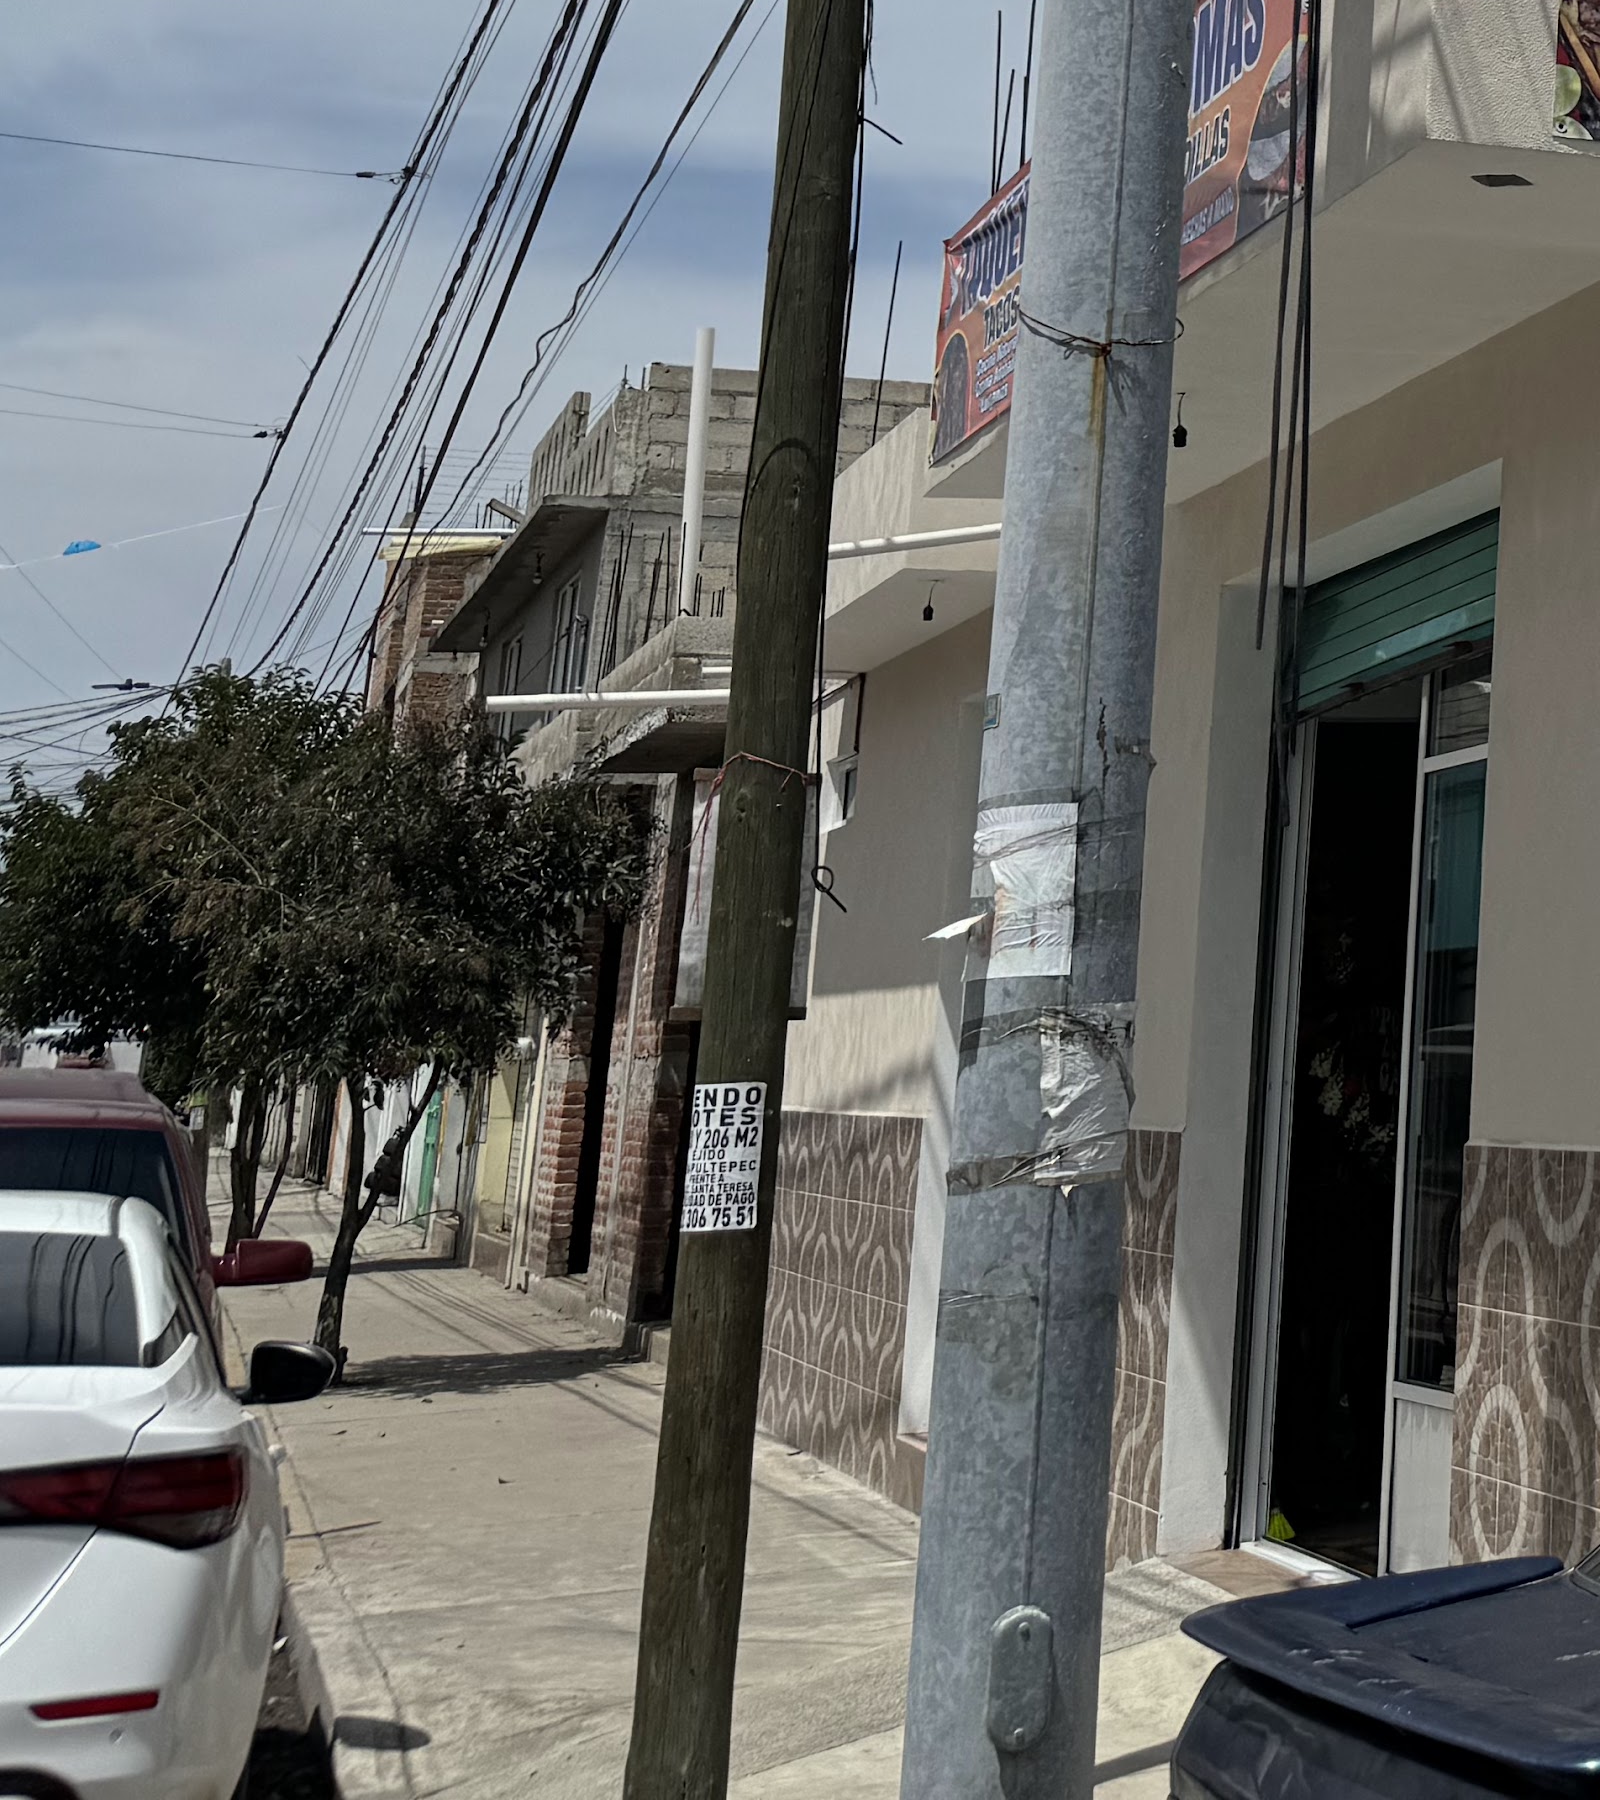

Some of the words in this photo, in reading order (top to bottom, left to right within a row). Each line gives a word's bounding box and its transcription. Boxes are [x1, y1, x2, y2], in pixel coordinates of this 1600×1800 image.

[703, 1128, 730, 1149] 206
[735, 1126, 759, 1148] M2
[718, 1173, 725, 1183] A
[718, 1182, 754, 1193] TERESA
[708, 1192, 722, 1206] DE
[725, 1191, 755, 1205] PAGO
[712, 1207, 731, 1228] 75
[736, 1206, 754, 1227] 51
